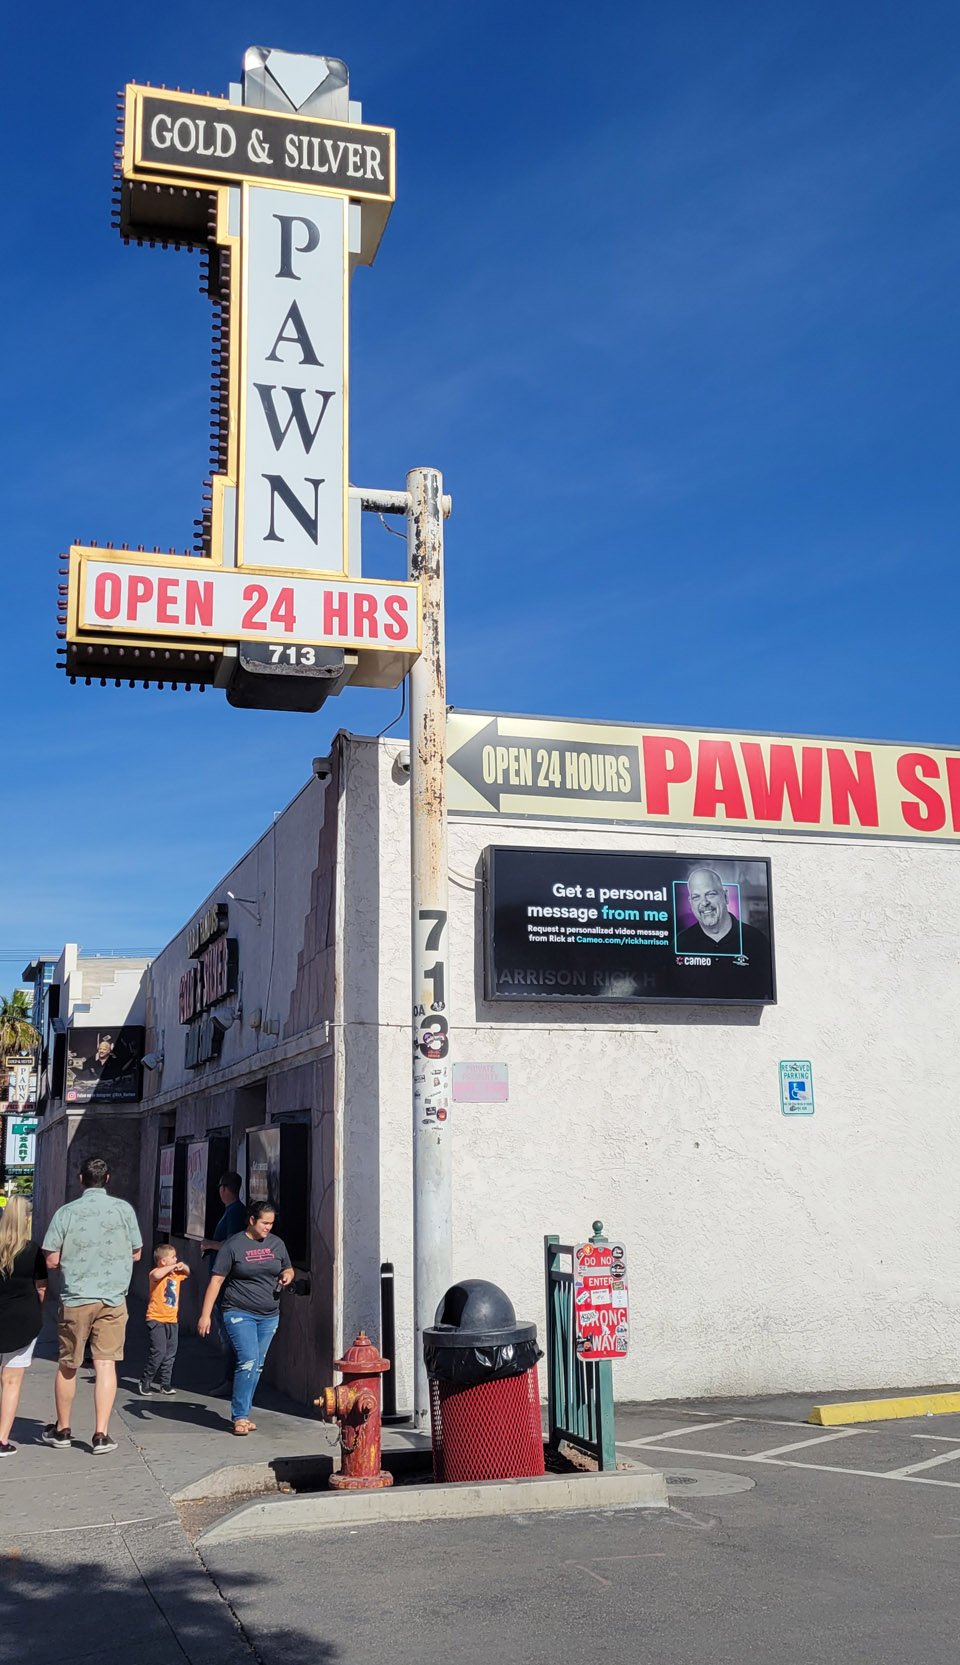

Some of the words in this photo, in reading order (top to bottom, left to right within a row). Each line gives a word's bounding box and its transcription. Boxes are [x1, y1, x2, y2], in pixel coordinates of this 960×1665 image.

[151, 114, 237, 158] GOLD
[247, 128, 273, 165] &
[285, 133, 385, 181] SILVER
[253, 213, 336, 546] PAWN
[94, 572, 214, 628] OPEN
[241, 584, 297, 633] 24
[323, 590, 409, 641] HRS
[269, 645, 316, 666] 713
[482, 745, 533, 786] OPEN
[536, 749, 562, 788] 24
[565, 751, 632, 793] HOURS
[642, 736, 880, 828] PAWN
[552, 883, 582, 898] Get
[586, 887, 596, 898] a
[599, 886, 667, 902] personal
[527, 905, 598, 922] message
[601, 905, 640, 920] from
[644, 909, 669, 921] me
[527, 924, 559, 934] Request
[566, 926, 614, 936] personalized
[614, 928, 636, 936] video
[636, 930, 669, 938] message
[529, 934, 548, 943] from
[549, 934, 566, 943] Rick
[576, 936, 669, 946] Cameo.com/rickharrison
[684, 957, 712, 967] cameo
[593, 972, 638, 987] RICK
[783, 1072, 809, 1080] PARKING
[584, 1257, 596, 1266] DO
[592, 1335, 617, 1351] WAY
